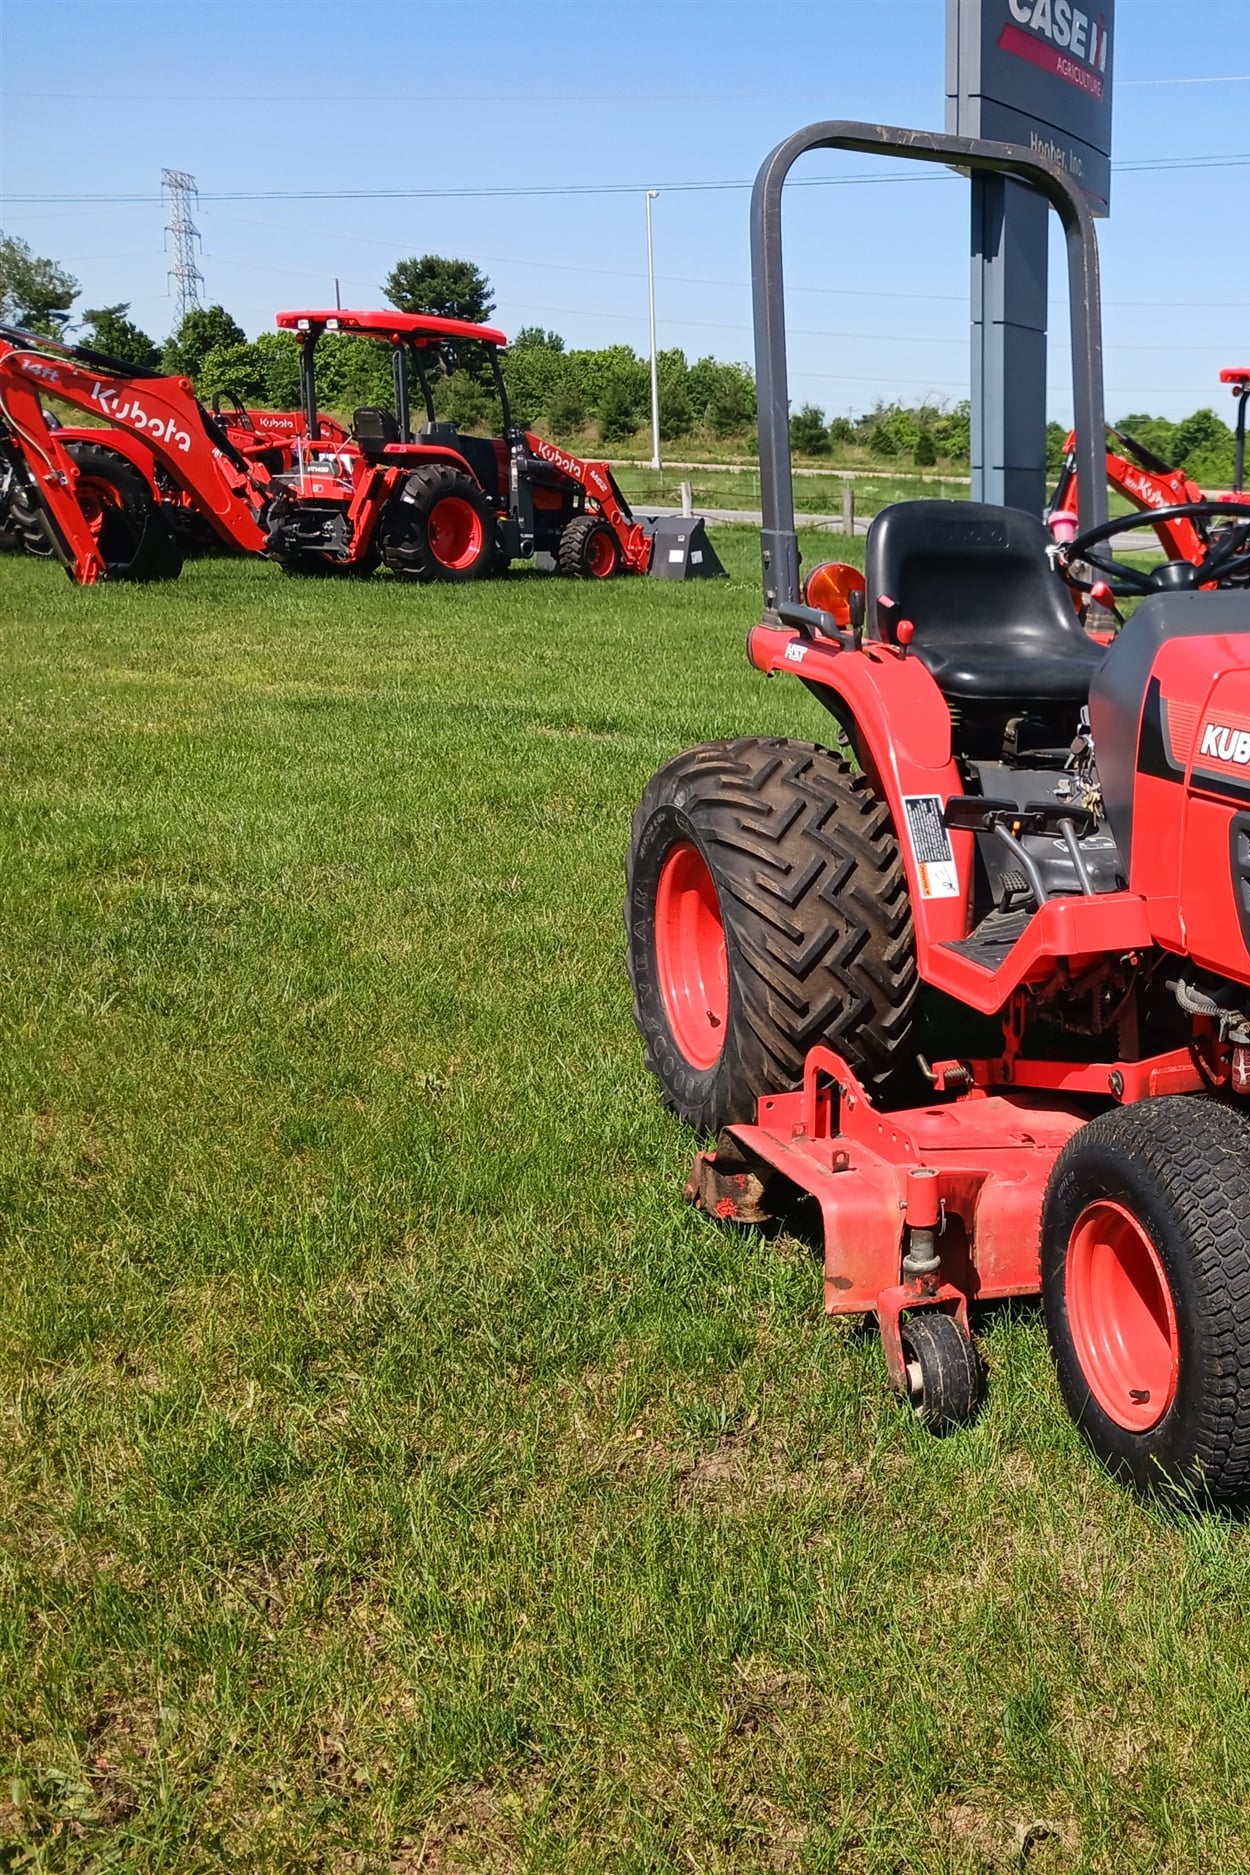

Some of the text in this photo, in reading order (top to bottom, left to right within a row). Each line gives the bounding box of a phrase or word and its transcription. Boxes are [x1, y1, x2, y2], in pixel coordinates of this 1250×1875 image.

[1057, 57, 1101, 97] AGRICULTURE
[21, 359, 59, 382] 14ft
[91, 381, 191, 453] Kubota
[260, 418, 294, 429] Kubota
[538, 441, 581, 478] Kubota
